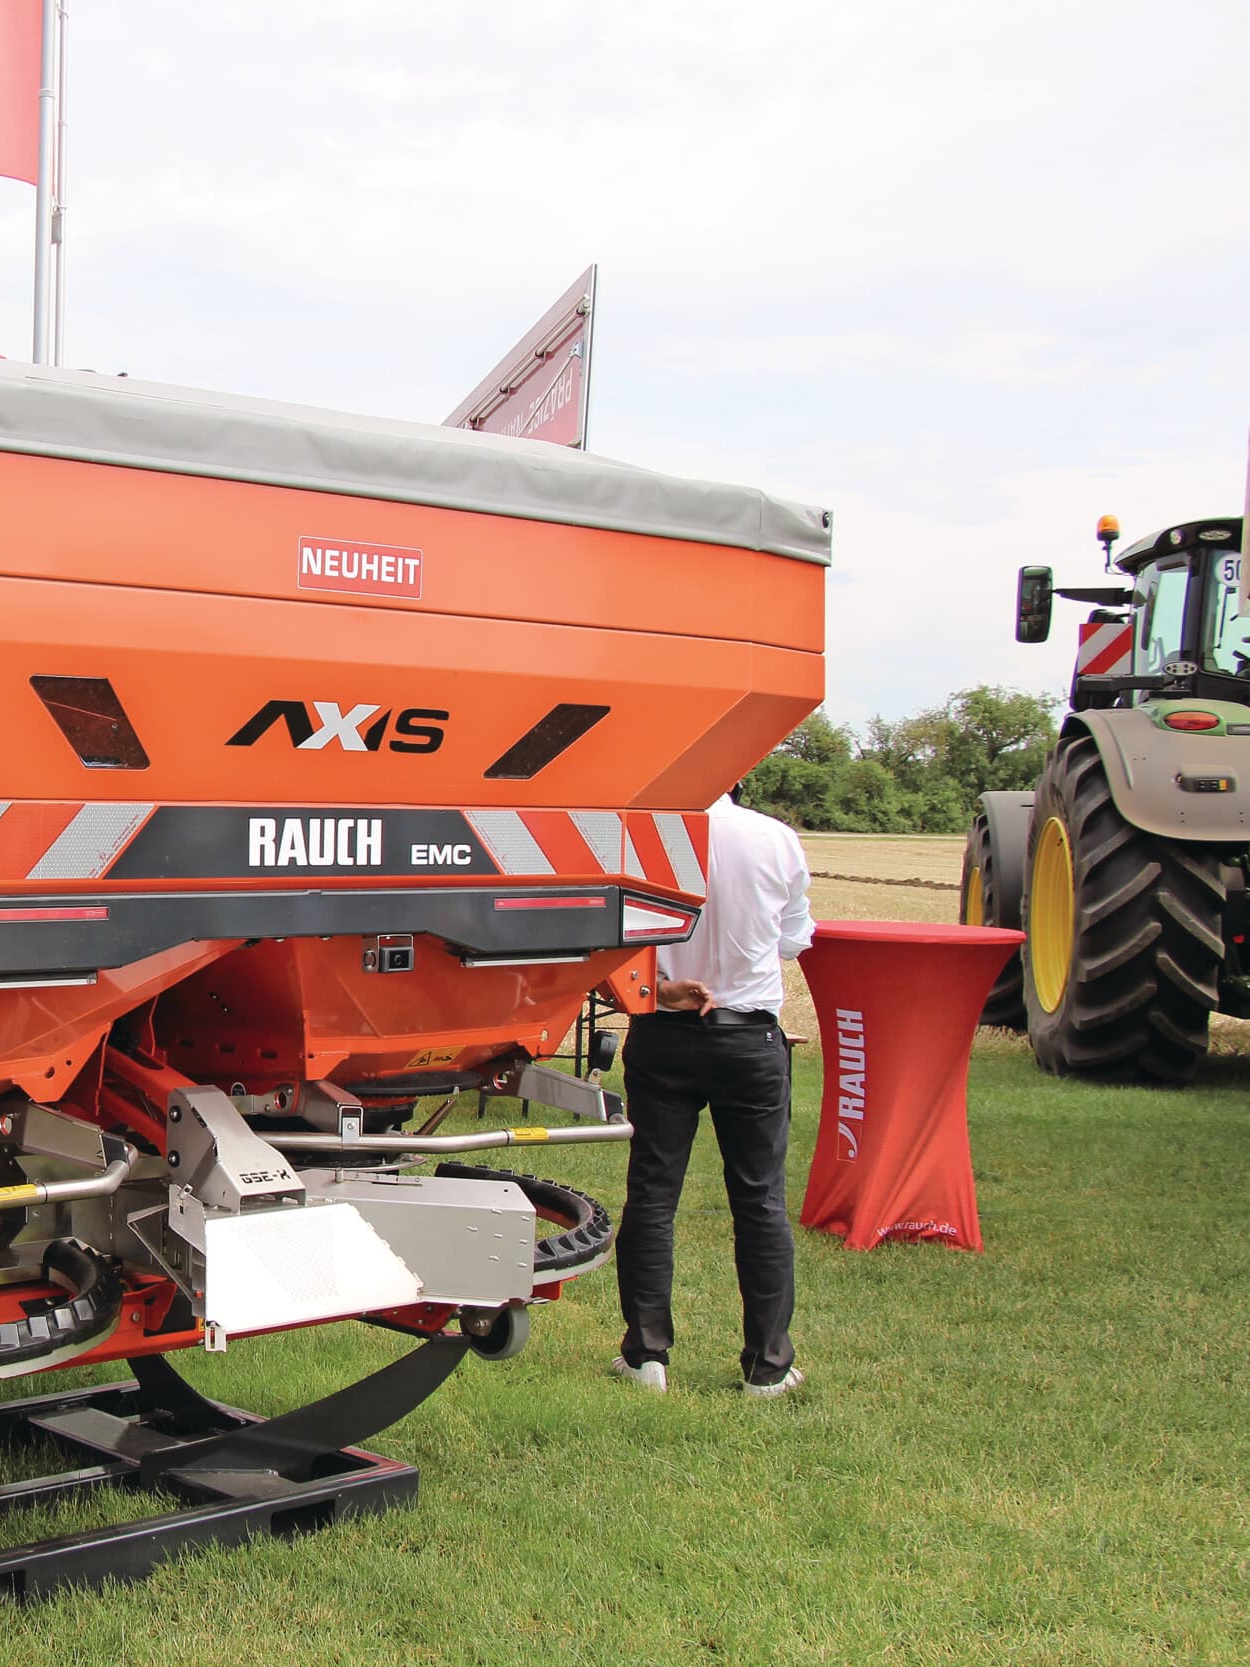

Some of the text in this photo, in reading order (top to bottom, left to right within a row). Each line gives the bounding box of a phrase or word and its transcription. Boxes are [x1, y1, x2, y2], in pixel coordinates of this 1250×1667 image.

[301, 546, 420, 585] NEUHEIT
[224, 700, 450, 754] AXIS
[248, 817, 472, 867] RAUCH EMC
[836, 1008, 866, 1121] RAUCH
[239, 1169, 291, 1184] GSE-X
